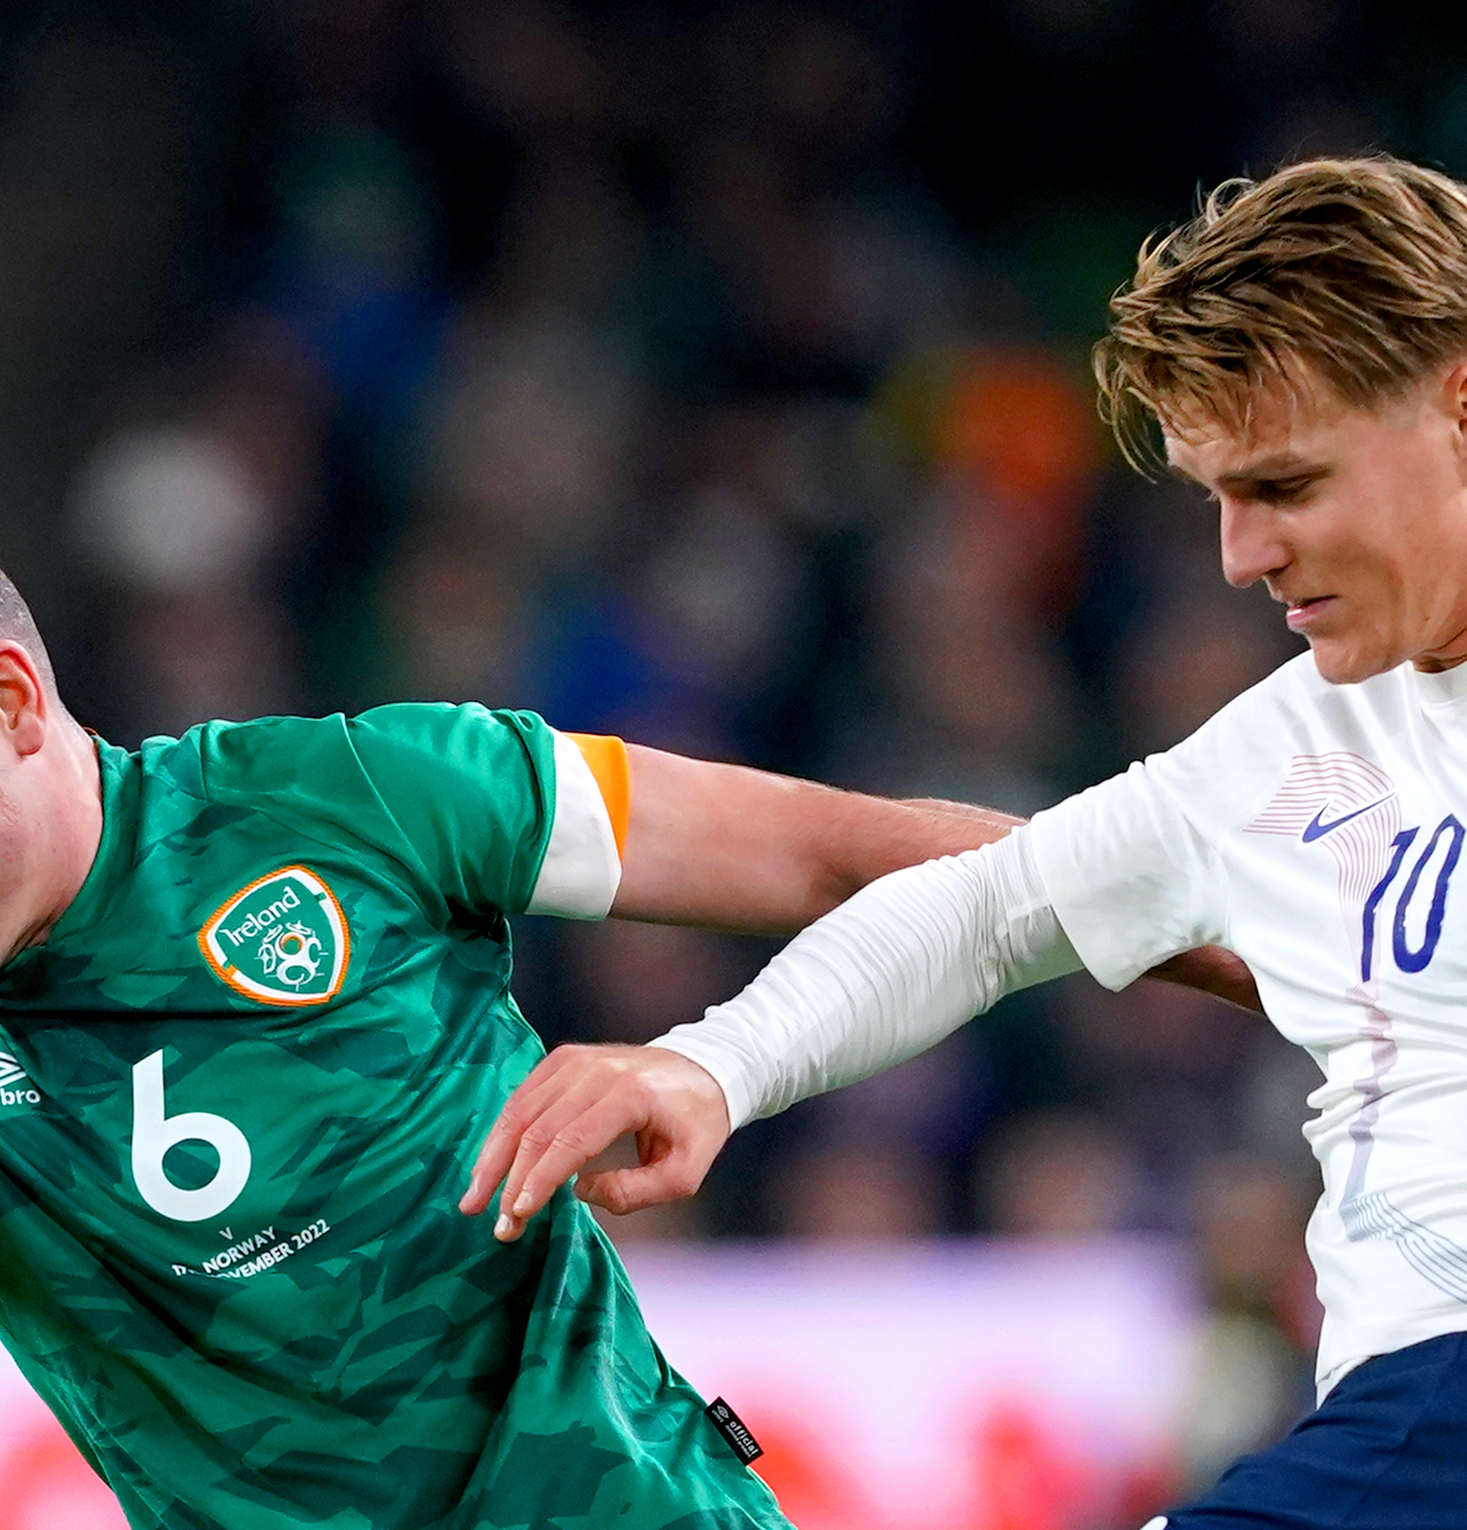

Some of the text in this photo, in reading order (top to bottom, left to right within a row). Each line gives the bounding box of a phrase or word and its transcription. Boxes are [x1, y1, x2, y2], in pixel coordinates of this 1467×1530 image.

[219, 886, 302, 947] Ireland
[1361, 813, 1466, 983] 10
[132, 1048, 252, 1222] 6
[202, 1226, 276, 1274] NORWAY
[291, 1218, 331, 1250] 2022
